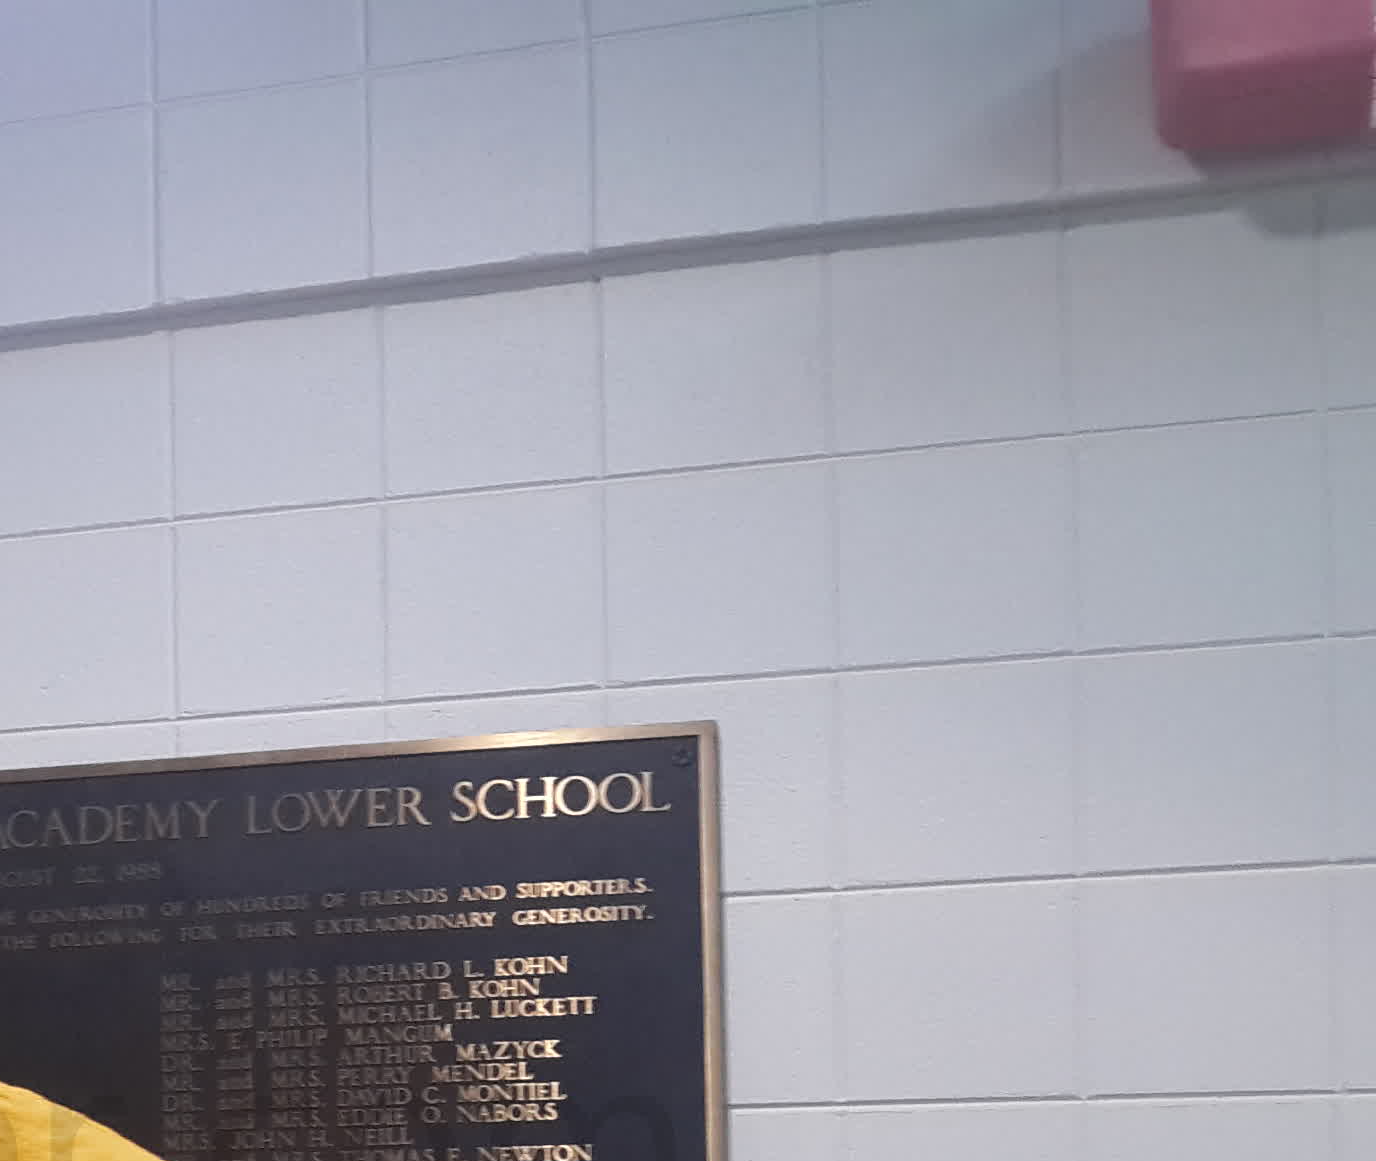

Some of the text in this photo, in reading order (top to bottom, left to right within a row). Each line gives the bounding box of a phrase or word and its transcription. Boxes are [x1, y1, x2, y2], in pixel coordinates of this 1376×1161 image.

[243, 785, 432, 836] LOWER
[449, 771, 672, 824] SCHOOL
[27, 902, 146, 925] GENEROSITY
[160, 900, 185, 919] OF
[196, 895, 310, 918] HUNDREDS
[321, 891, 347, 911] OF
[360, 887, 449, 908] FRIENDS
[457, 884, 507, 902] AND
[514, 877, 653, 900] SUPPORTERS.
[0, 934, 39, 952] THE
[48, 928, 161, 950] FOLLOWING
[177, 925, 218, 945] FOR
[234, 920, 297, 942] THEIR
[313, 911, 497, 938] EXTRAORDINARY
[511, 904, 654, 927] GENEROSITY.
[264, 967, 328, 988] MRS.
[335, 961, 451, 984] RICHARD
[463, 960, 485, 979] L.
[493, 955, 568, 977] KOHN
[266, 988, 328, 1008] MRS.
[335, 983, 425, 1005] ROBERT
[437, 981, 459, 1001] B.
[468, 977, 540, 999] KOHN
[267, 1008, 328, 1028] MRS.
[336, 1003, 443, 1025] MICHAEL
[455, 1001, 481, 1020] H.
[489, 995, 598, 1018] LUCKETT
[255, 1029, 328, 1048] PHILIP
[344, 1023, 453, 1046] MANGUM
[270, 1049, 328, 1068] MRS.
[336, 1044, 437, 1066] ARTHUR
[456, 1039, 563, 1062] MAZYCK
[270, 1069, 328, 1088] MRS.
[336, 1065, 416, 1087] PERRY
[431, 1061, 536, 1082] MENDEL
[270, 1090, 328, 1109] MRS.
[336, 1086, 412, 1108] DAVID
[420, 1086, 447, 1105] C.
[456, 1080, 568, 1103] MONTIEL
[270, 1109, 328, 1128] MRS.
[335, 1107, 409, 1128] EDDIE
[421, 1105, 448, 1124] O.
[456, 1102, 560, 1123] NABORS
[231, 1130, 298, 1150] JOHN
[310, 1128, 335, 1148] H.
[346, 1126, 415, 1147] NEILL
